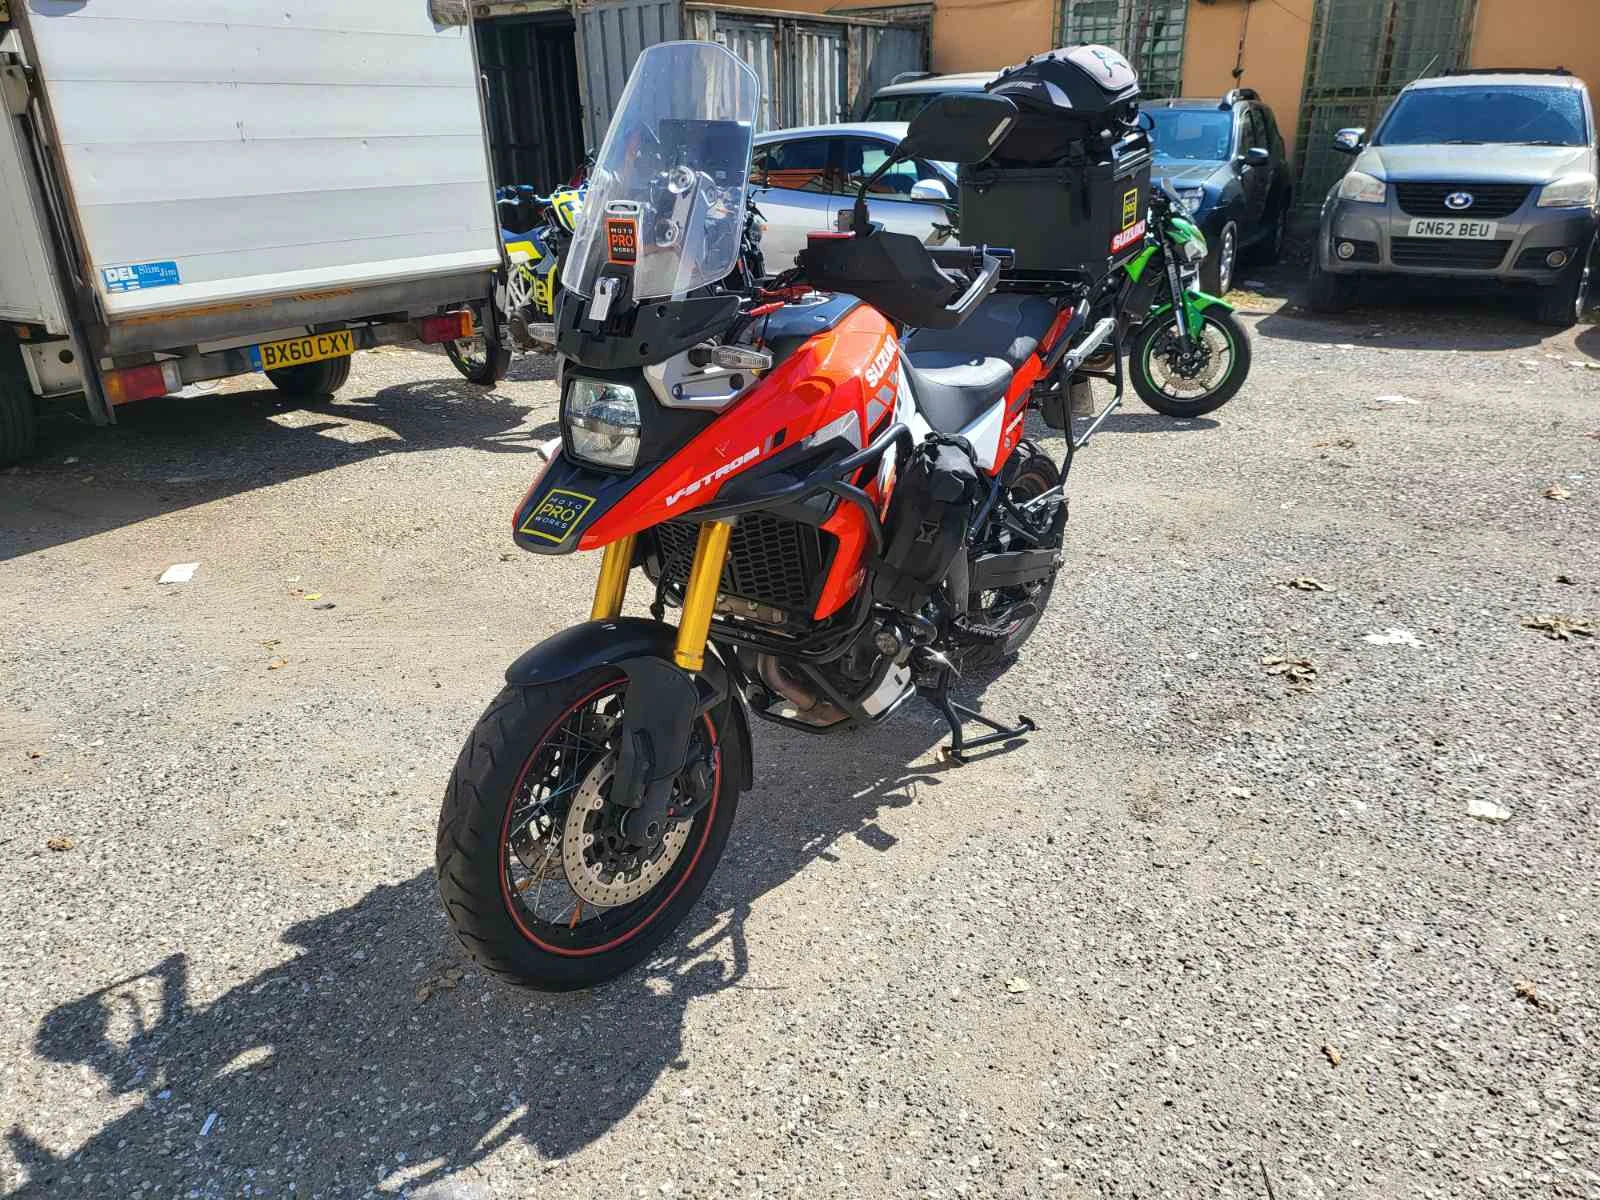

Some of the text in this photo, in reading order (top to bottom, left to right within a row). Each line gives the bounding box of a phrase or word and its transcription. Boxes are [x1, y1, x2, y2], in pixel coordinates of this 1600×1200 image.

[1415, 221, 1490, 237] GN62 BEU
[611, 234, 633, 247] PRO
[105, 265, 139, 283] DEL
[263, 332, 350, 365] BX60 CXY
[549, 496, 583, 510] MOTO
[539, 503, 576, 522] PRO
[535, 515, 569, 529] WORKS
